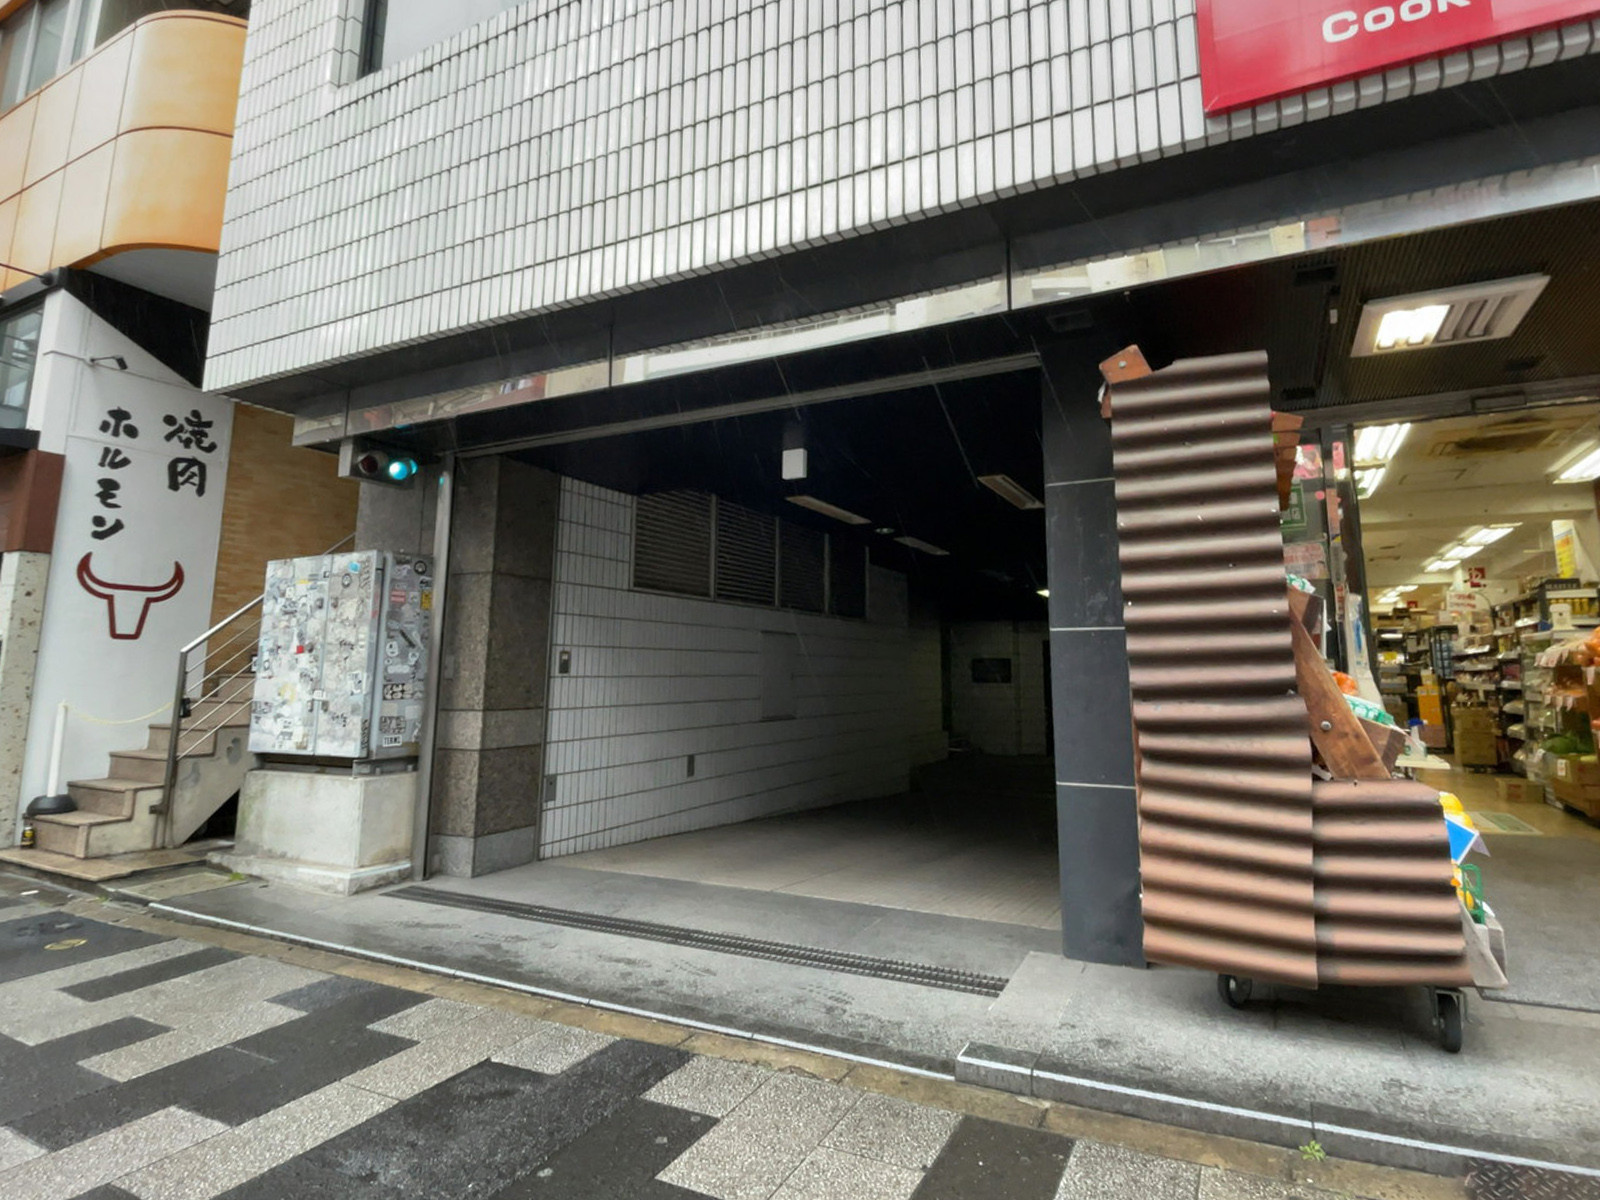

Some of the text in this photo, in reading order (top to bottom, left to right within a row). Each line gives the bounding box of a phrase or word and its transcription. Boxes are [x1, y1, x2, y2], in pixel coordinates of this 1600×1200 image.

[91, 406, 139, 540] ホルモン
[163, 409, 217, 497] 焼肉
